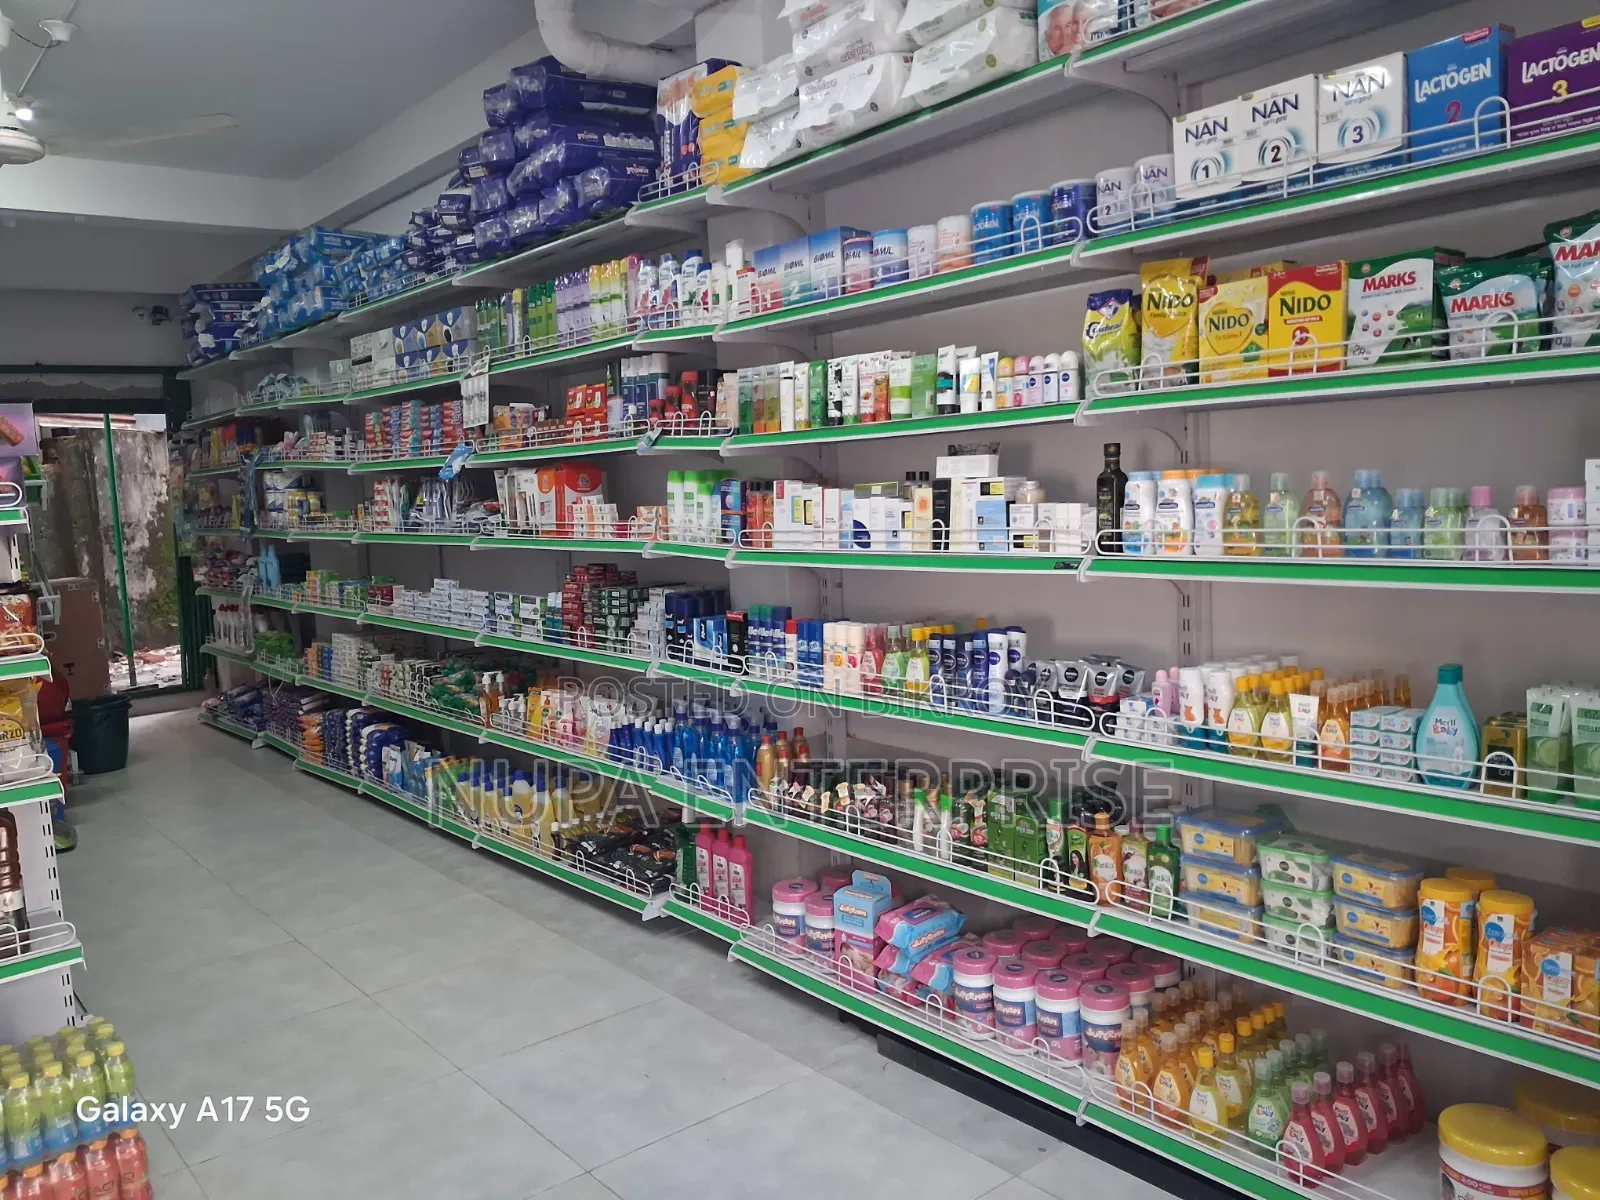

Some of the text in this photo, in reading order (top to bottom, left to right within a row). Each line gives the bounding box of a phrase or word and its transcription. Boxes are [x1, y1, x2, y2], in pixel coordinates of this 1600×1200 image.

[1332, 72, 1385, 102] NAN
[1414, 57, 1492, 103] LACTOGEN
[1552, 79, 1569, 103] 3
[1252, 93, 1299, 123] NAN
[1446, 100, 1463, 124] 2
[1185, 116, 1228, 143] NAN
[1352, 125, 1364, 144] 3
[1270, 144, 1282, 163] 2
[1202, 165, 1209, 179] 1
[1555, 240, 1600, 262] MAR
[1362, 270, 1417, 293] MARKS
[1146, 293, 1194, 312] NIDO
[1280, 294, 1332, 317] NIDO
[1450, 291, 1515, 314] MARKS
[1208, 313, 1250, 333] NIDO
[1432, 724, 1458, 736] Baby
